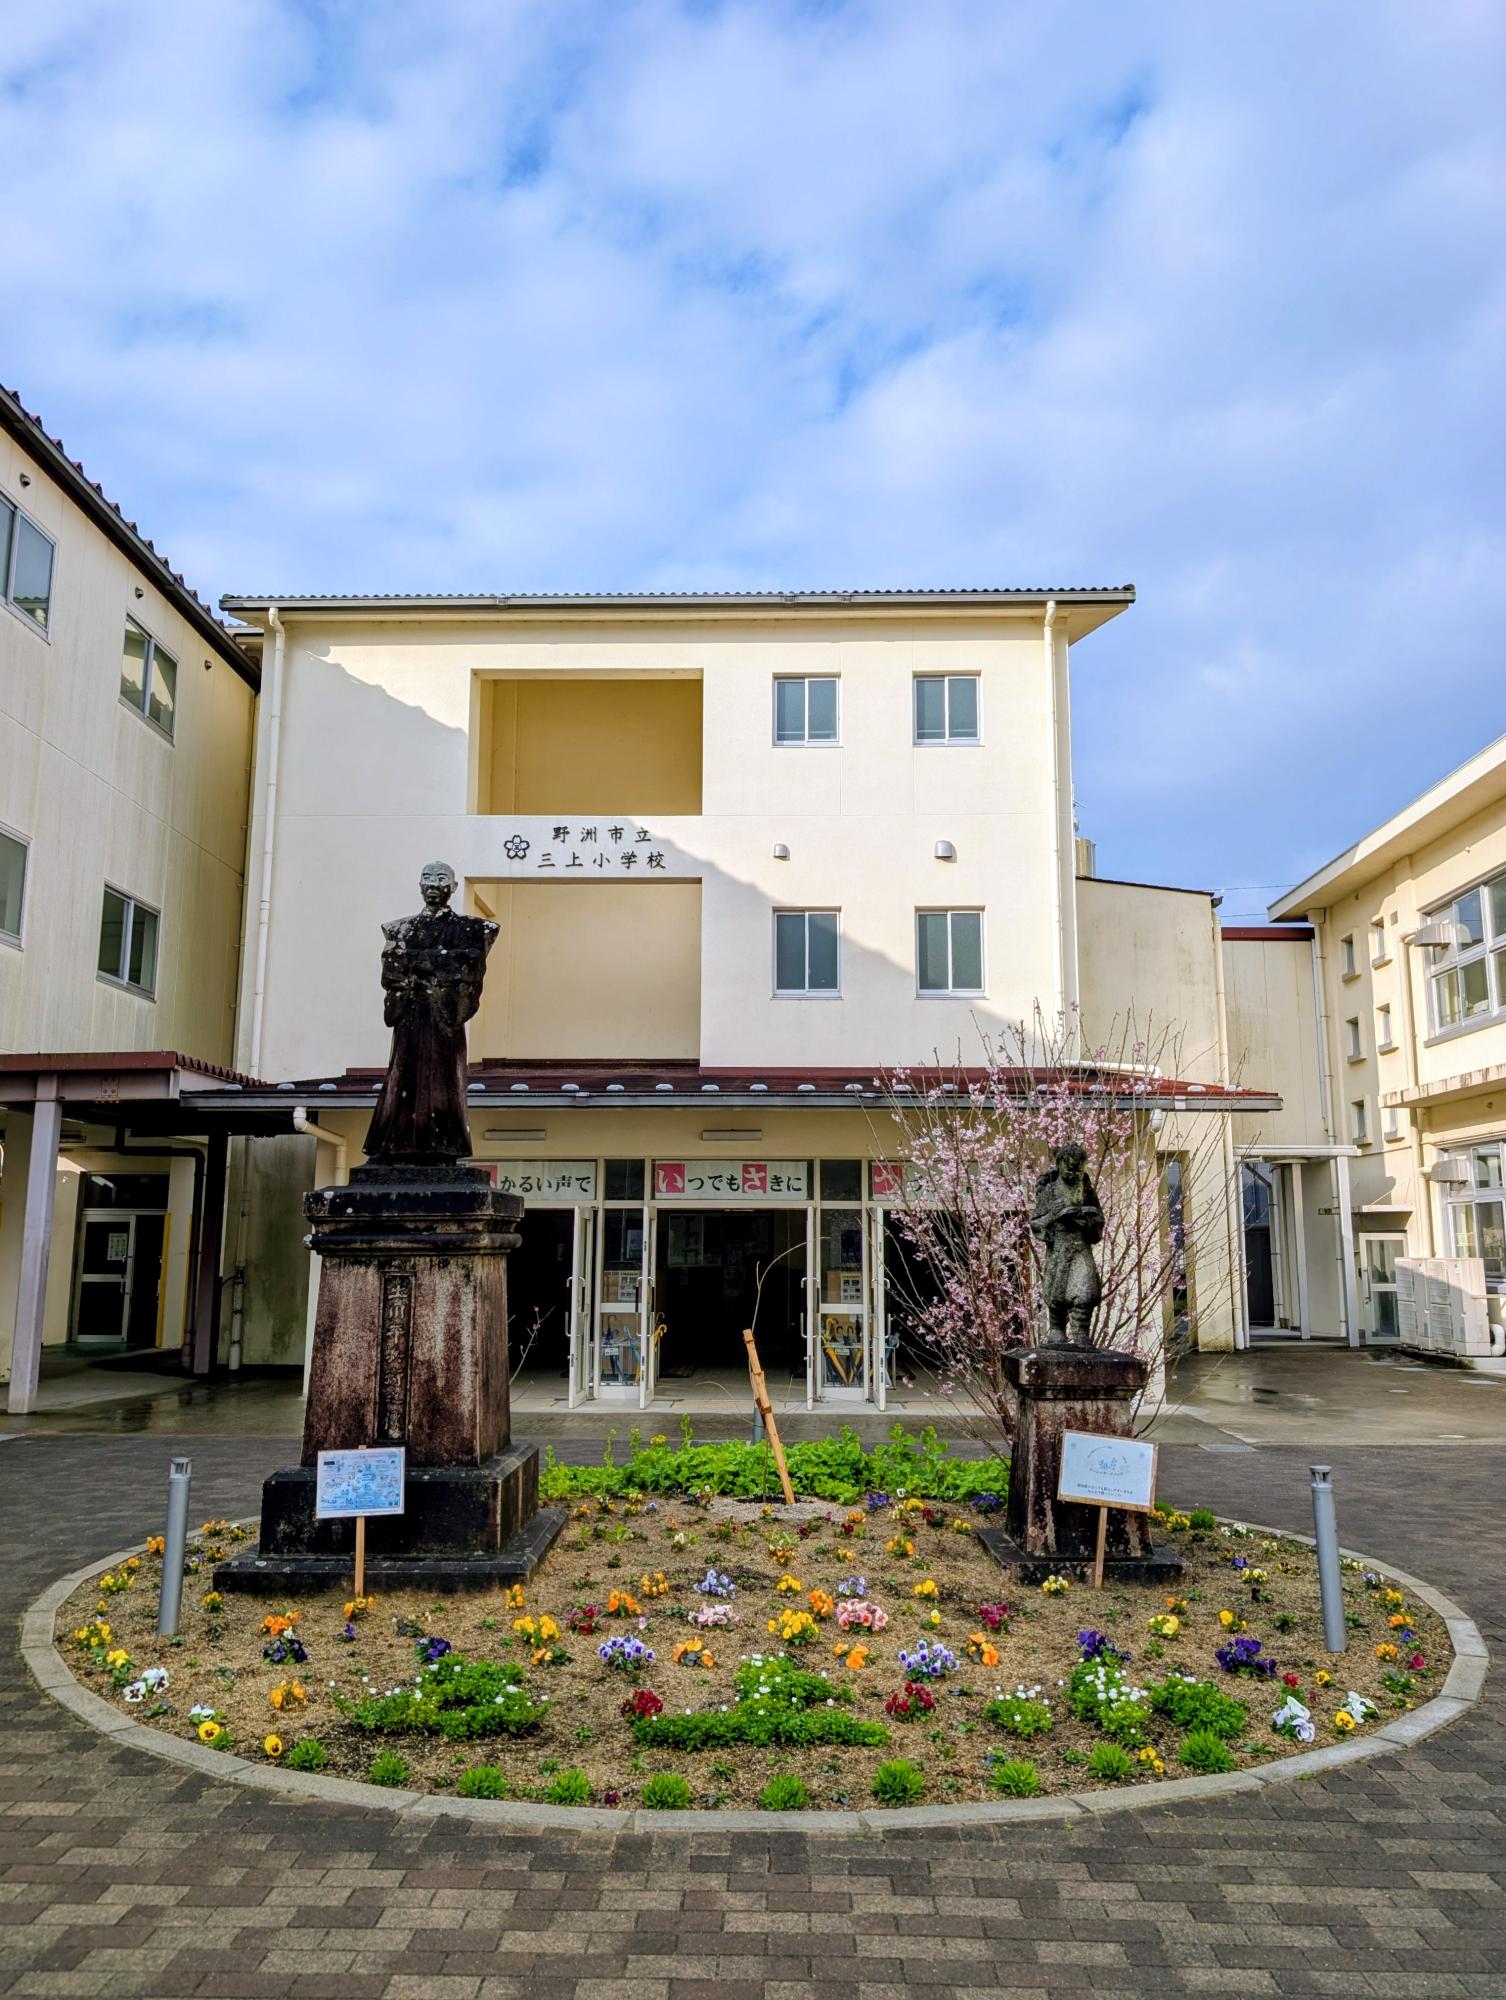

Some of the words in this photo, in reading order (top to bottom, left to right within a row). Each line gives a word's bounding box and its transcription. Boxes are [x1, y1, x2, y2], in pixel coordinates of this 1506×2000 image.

[552, 826, 652, 843] 野洲市立
[537, 851, 666, 869] 三上小学校
[489, 1175, 591, 1193] かるい声で
[658, 1167, 802, 1193] いつでもさきに
